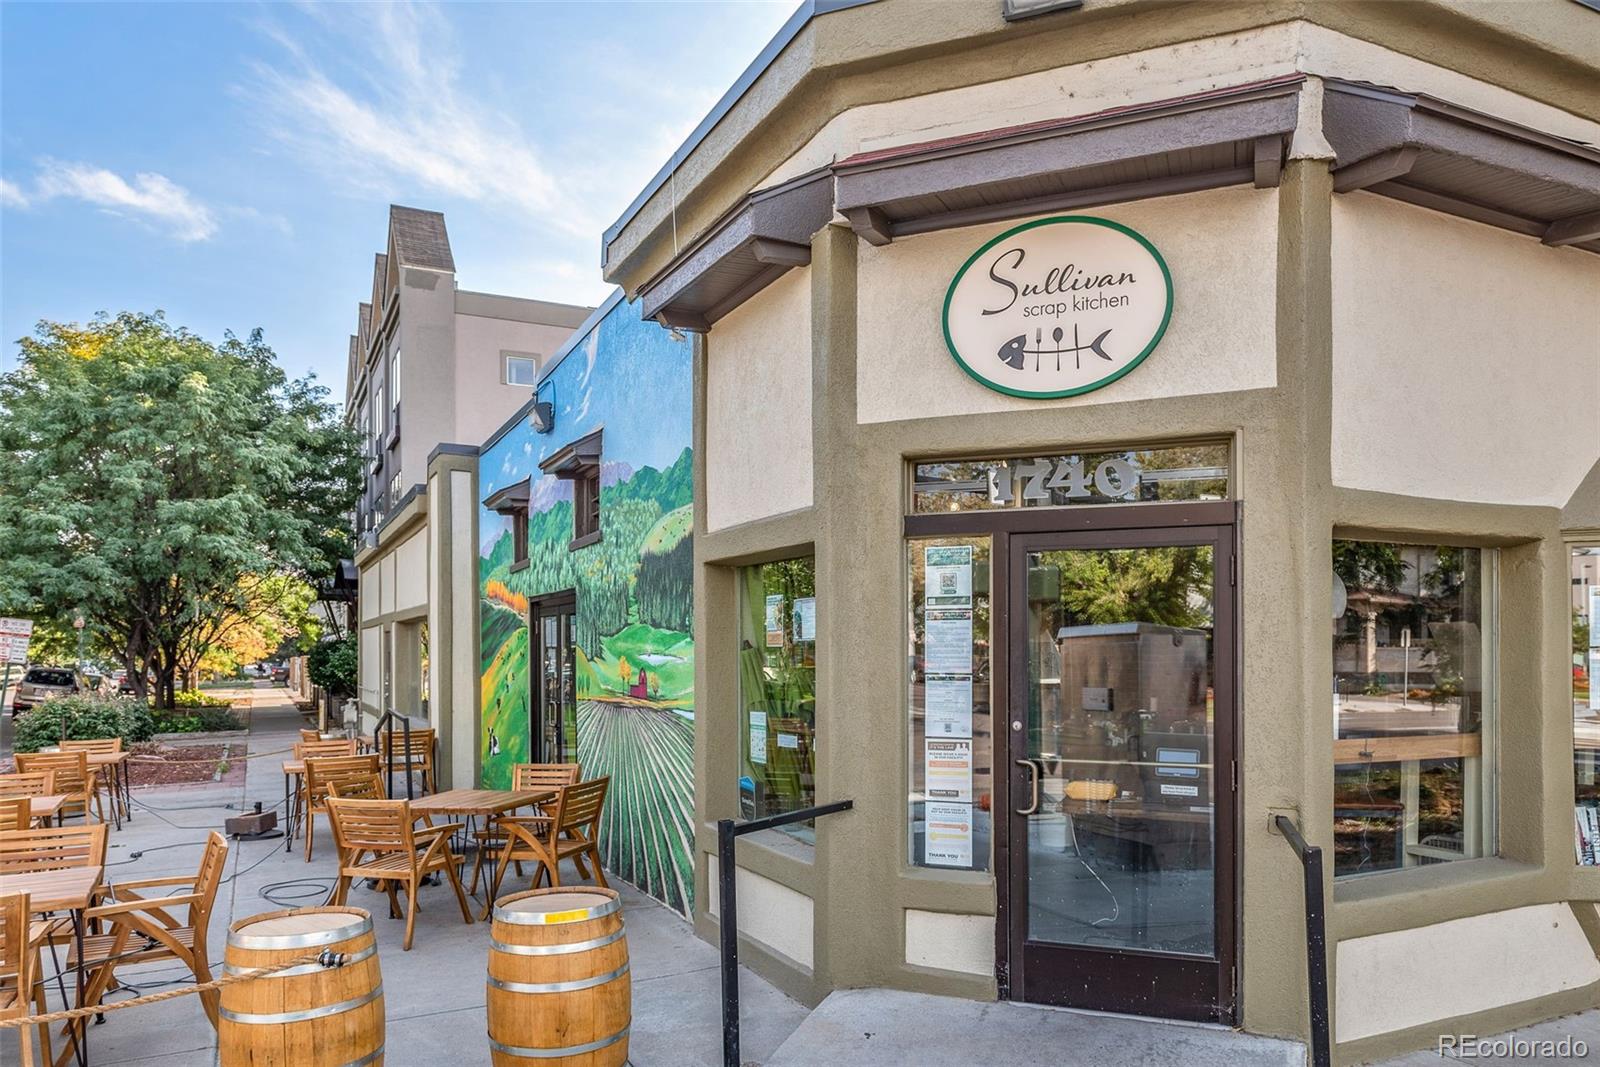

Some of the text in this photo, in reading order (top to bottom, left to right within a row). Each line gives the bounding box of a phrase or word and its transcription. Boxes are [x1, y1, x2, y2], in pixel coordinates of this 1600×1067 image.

[981, 248, 1136, 316] Sullivan
[1023, 291, 1129, 318] scrap kitchen
[993, 457, 1139, 501] 1740
